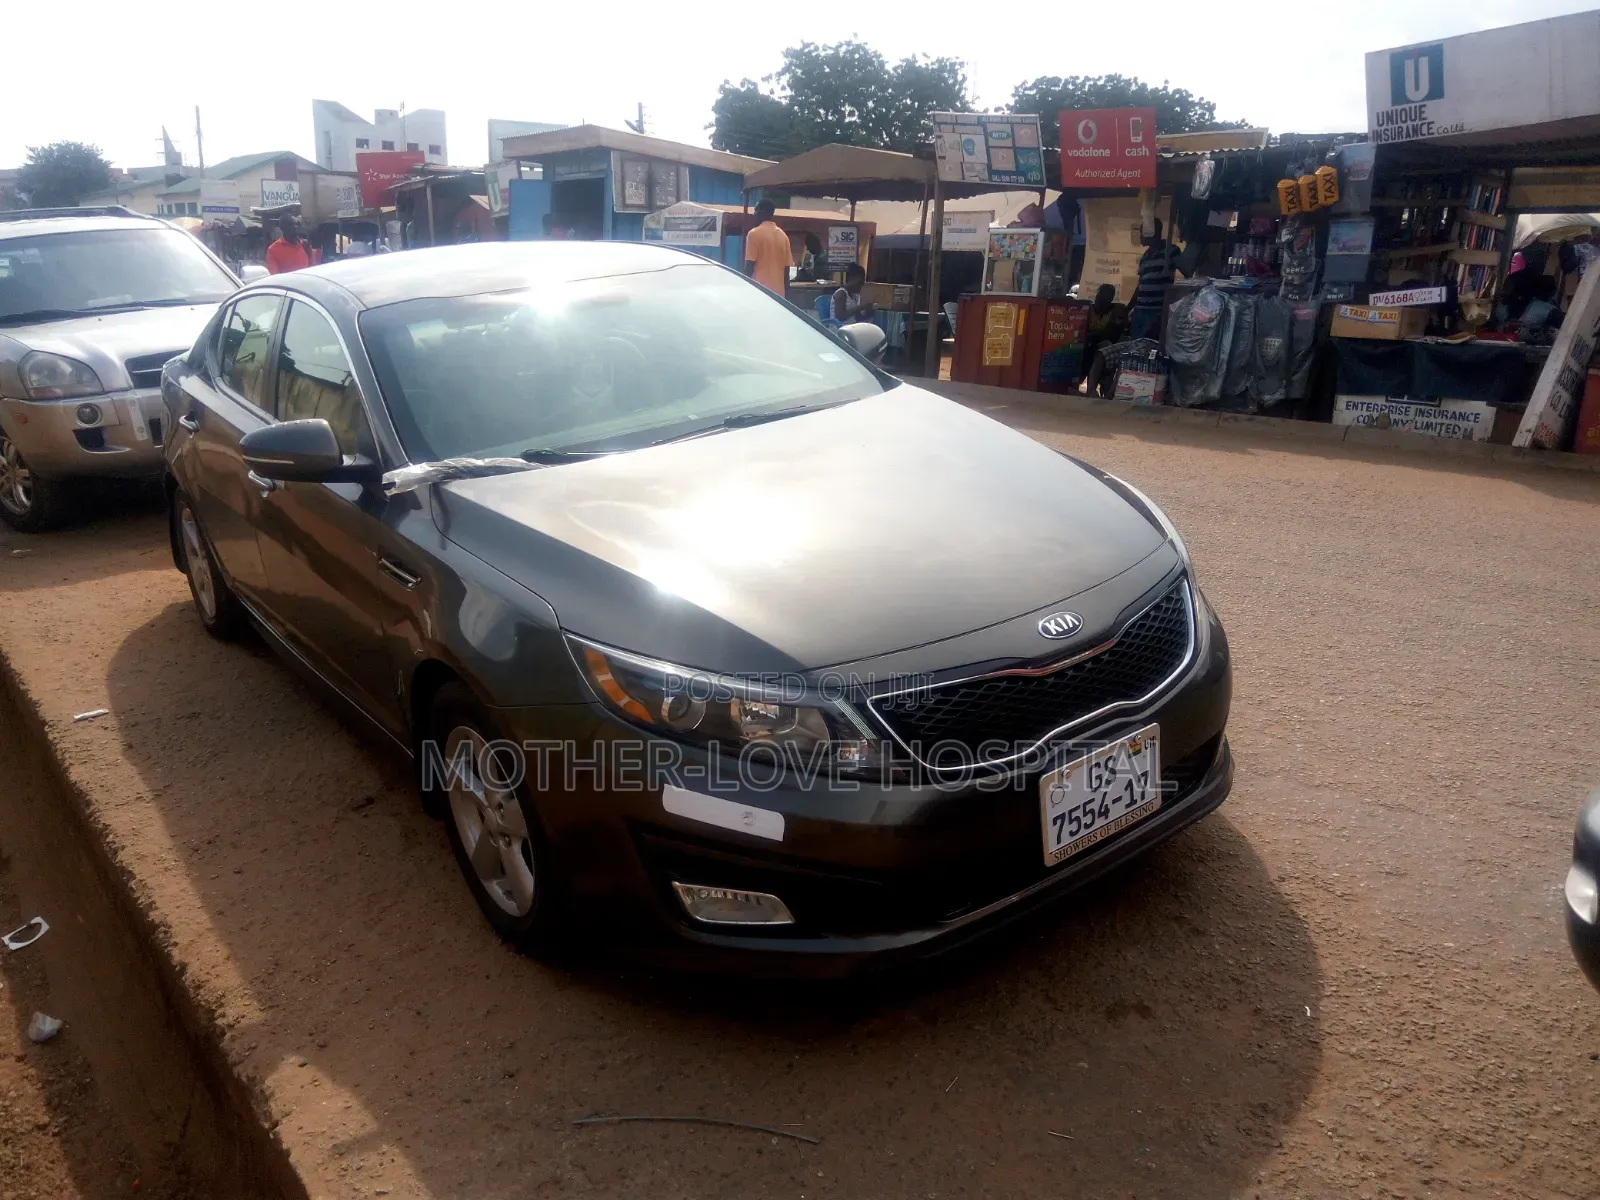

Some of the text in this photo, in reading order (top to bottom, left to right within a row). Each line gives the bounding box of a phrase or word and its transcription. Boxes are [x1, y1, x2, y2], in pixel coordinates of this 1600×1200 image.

[1404, 56, 1430, 102] U
[1375, 104, 1428, 127] UNIQUE
[992, 131, 1008, 139] MTN
[1372, 121, 1435, 143] INSURANCE
[1067, 145, 1149, 157] vodafone cash
[1074, 169, 1142, 179] Authorized Agent
[1323, 173, 1335, 202] TAXI
[1285, 186, 1297, 213] TAXI
[840, 231, 855, 242] SIC
[1348, 308, 1368, 319] TAXI
[1377, 312, 1398, 321] TAXI
[1048, 330, 1065, 341] here
[1345, 400, 1481, 424] ENTERPRISE INSURANCE
[1356, 414, 1462, 436] COMANY LIMITED
[1043, 614, 1080, 635] KIA
[1088, 755, 1118, 793] GS
[1052, 769, 1150, 845] 7554-17
[1053, 802, 1155, 862] SHOWERS OF BLESSING
